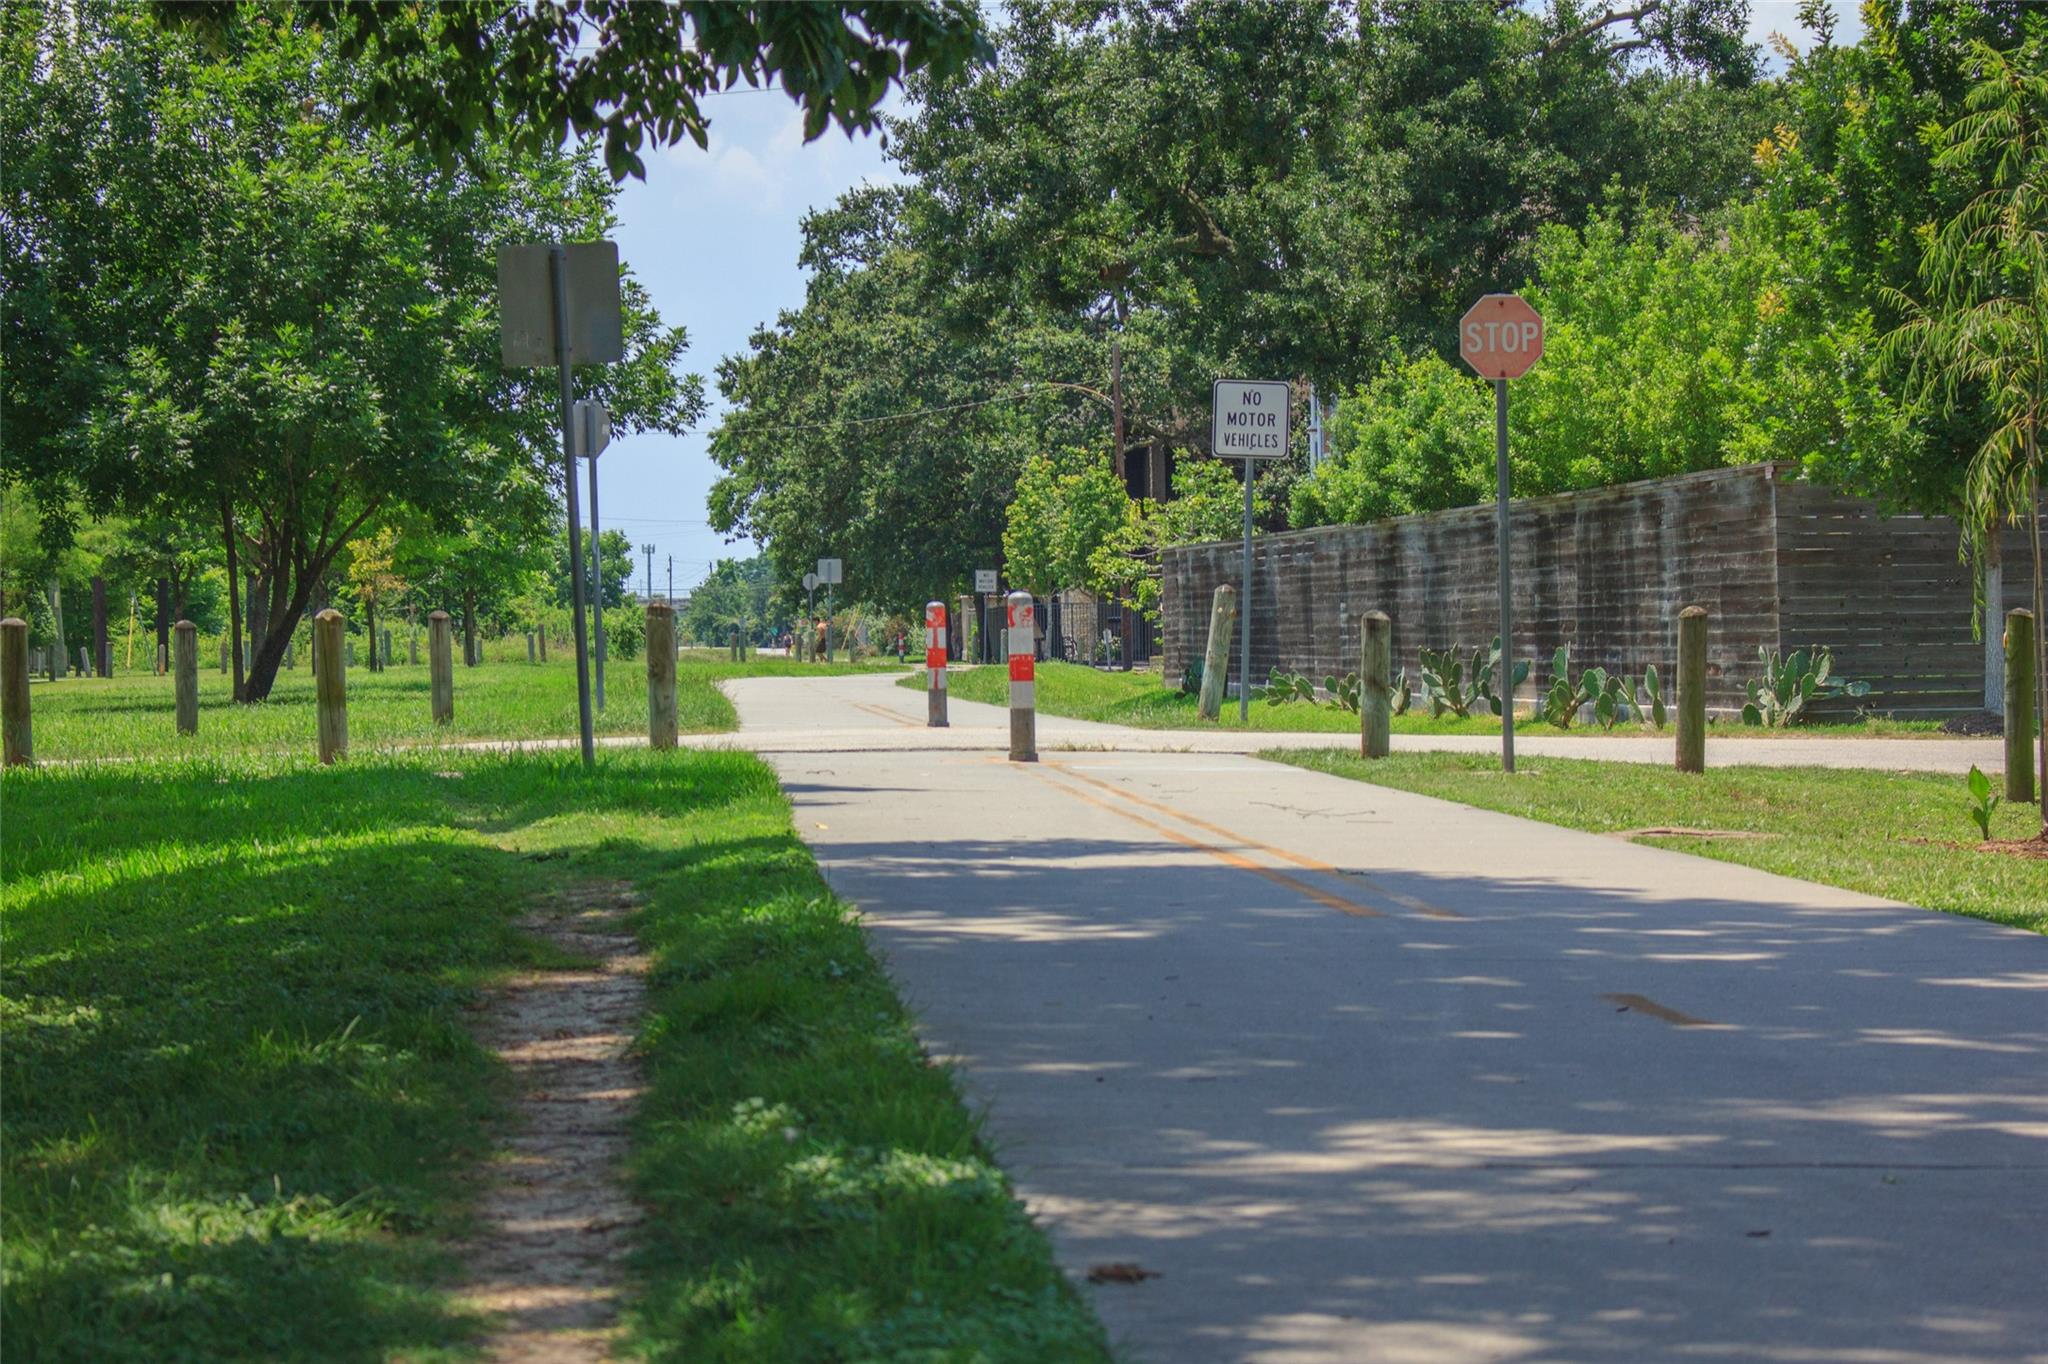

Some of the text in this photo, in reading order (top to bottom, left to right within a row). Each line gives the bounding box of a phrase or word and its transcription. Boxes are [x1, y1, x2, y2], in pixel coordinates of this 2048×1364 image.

[1466, 321, 1539, 353] STOP
[1243, 391, 1261, 406] NO
[1227, 412, 1276, 427] MOTOR
[1224, 432, 1278, 448] VEHICLES
